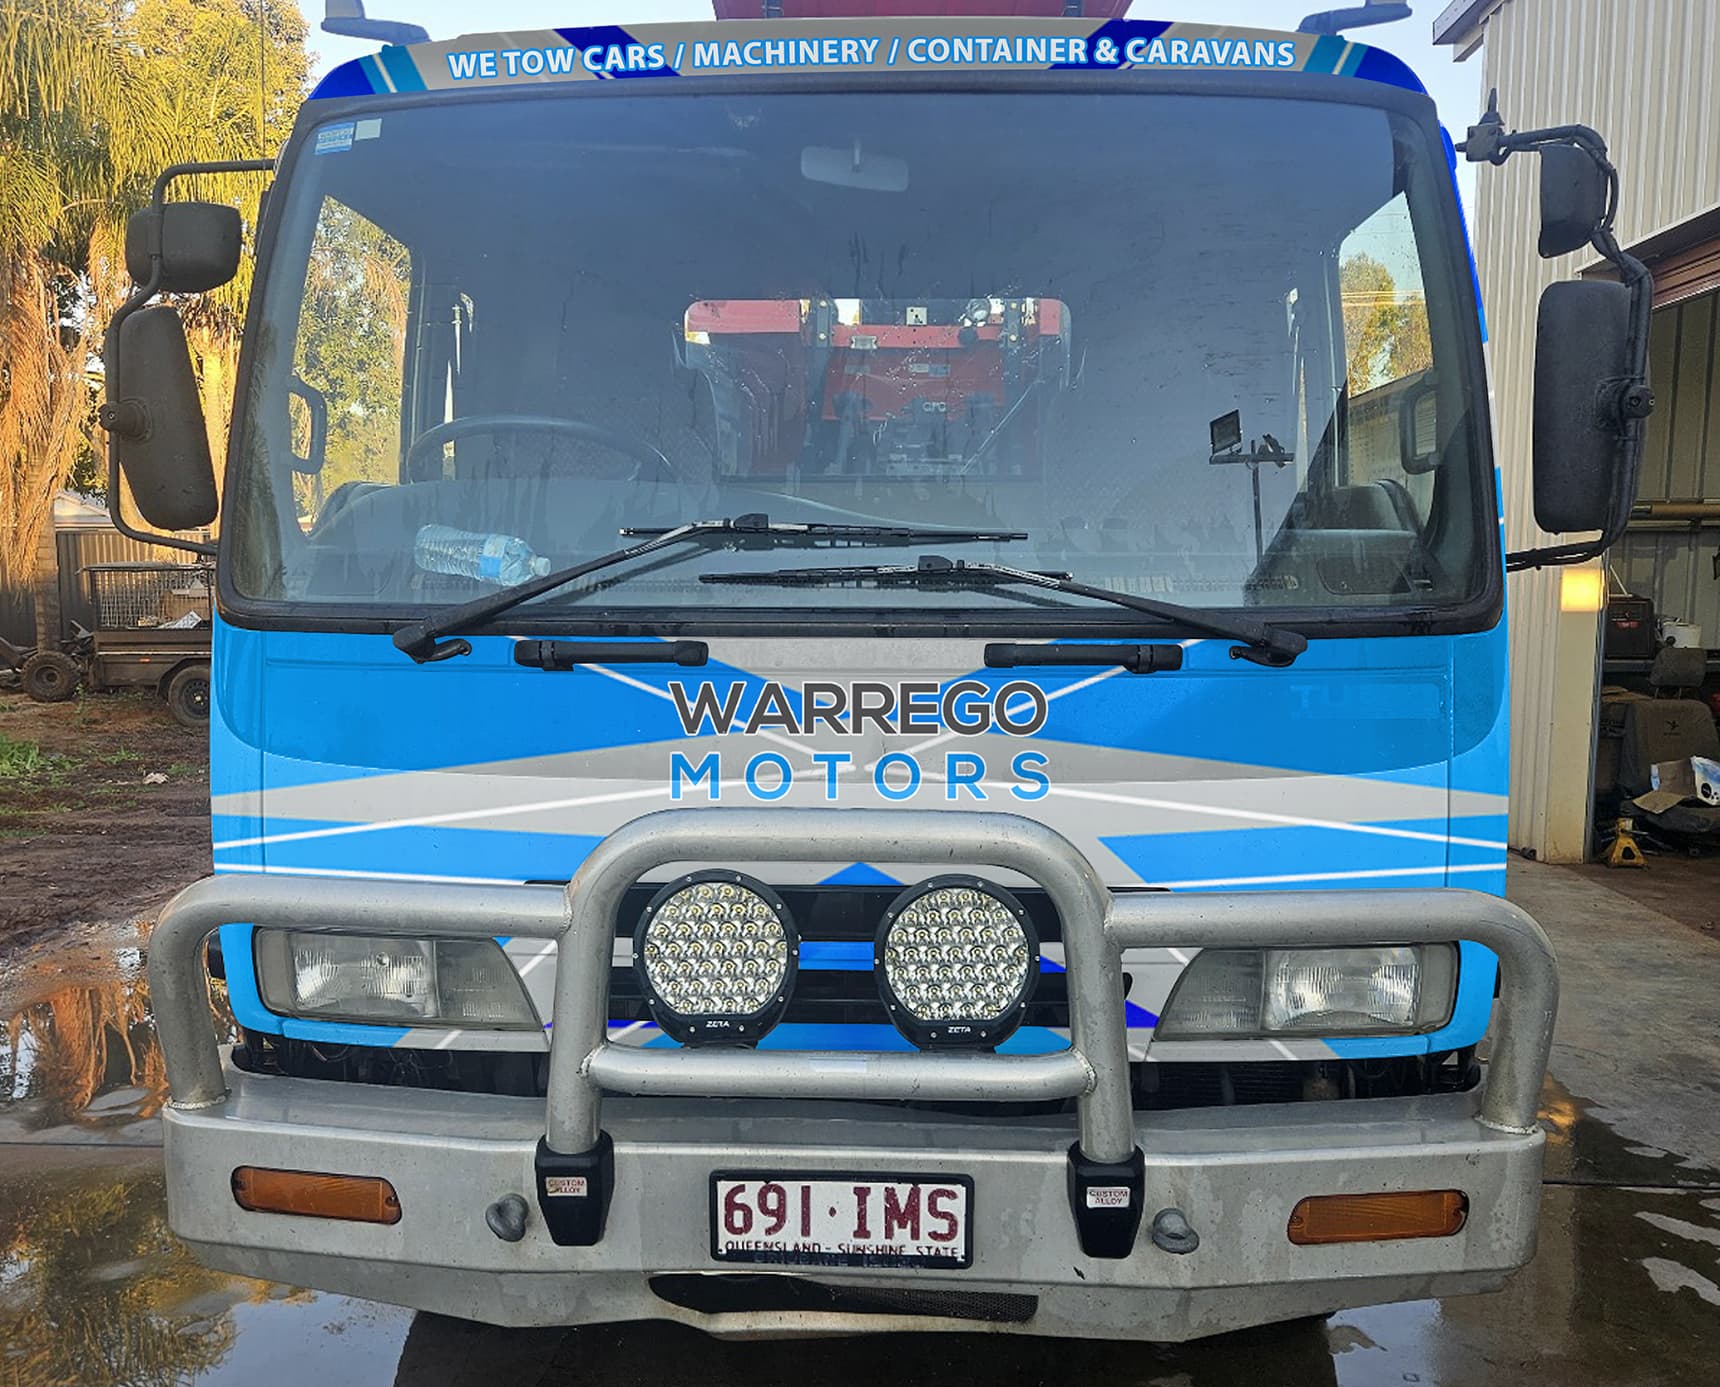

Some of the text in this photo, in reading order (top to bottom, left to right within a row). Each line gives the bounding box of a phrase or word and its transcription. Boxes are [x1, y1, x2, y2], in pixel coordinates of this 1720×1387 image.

[448, 37, 1296, 79] WE TOW CARS / MACHINERY / CONTAINER & CARAVANS
[669, 680, 1049, 737] WARREGO
[670, 751, 1051, 802] MOTORS
[725, 1241, 821, 1254] QUEENSLAND
[838, 1244, 906, 1256] SUNSHINE
[916, 1246, 957, 1257] STATE
